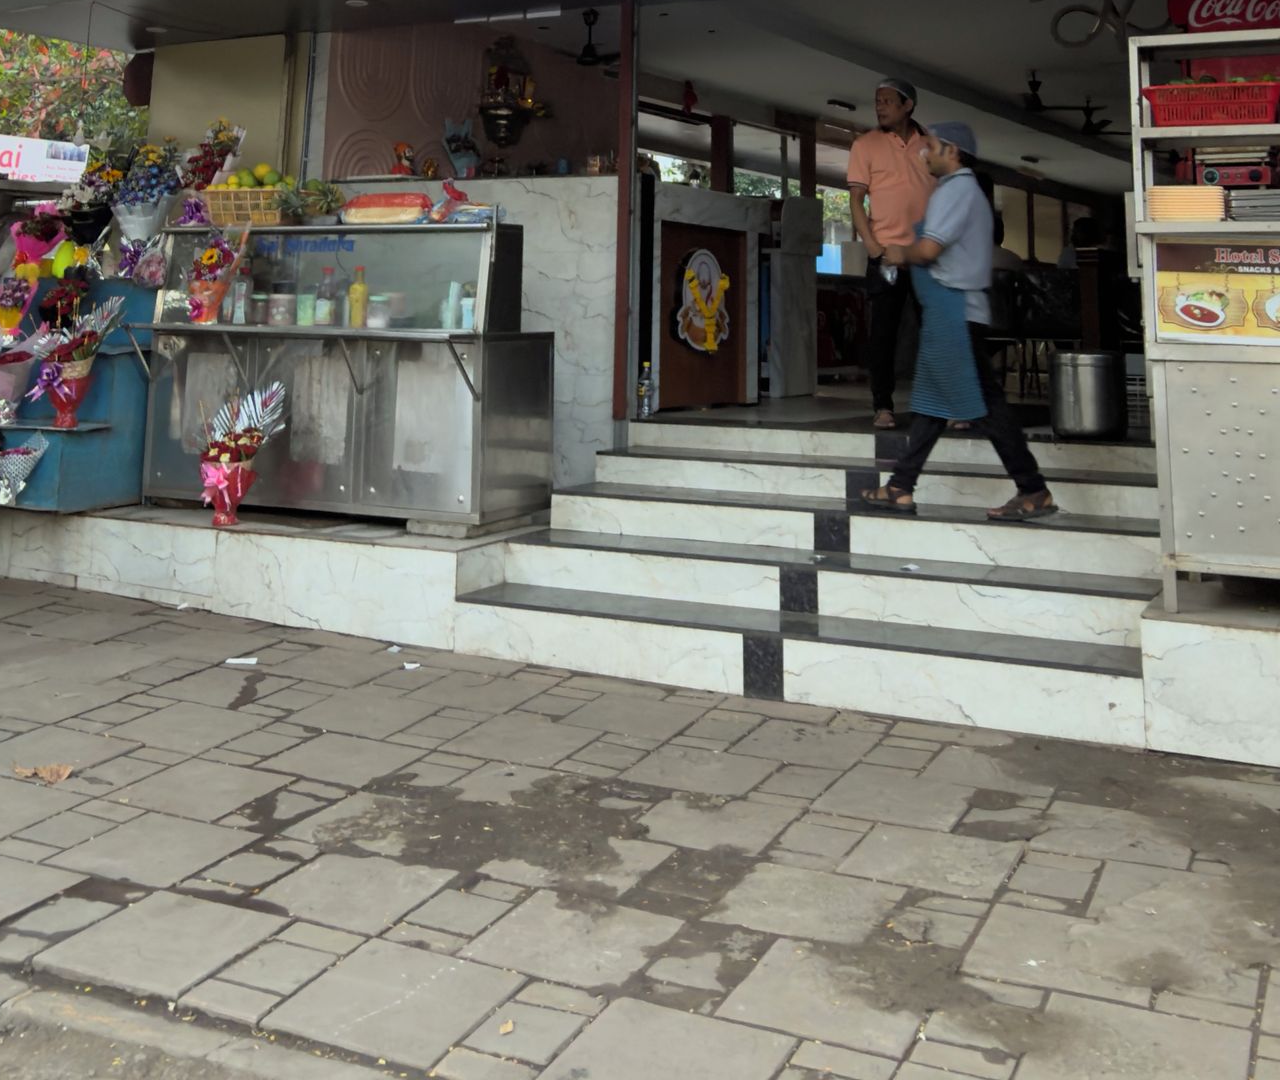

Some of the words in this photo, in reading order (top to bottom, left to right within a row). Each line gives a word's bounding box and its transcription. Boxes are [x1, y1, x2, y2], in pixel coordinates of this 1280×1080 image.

[1214, 247, 1264, 265] Hotel
[1237, 265, 1272, 274] SNACKS
[1273, 266, 1280, 275] &
